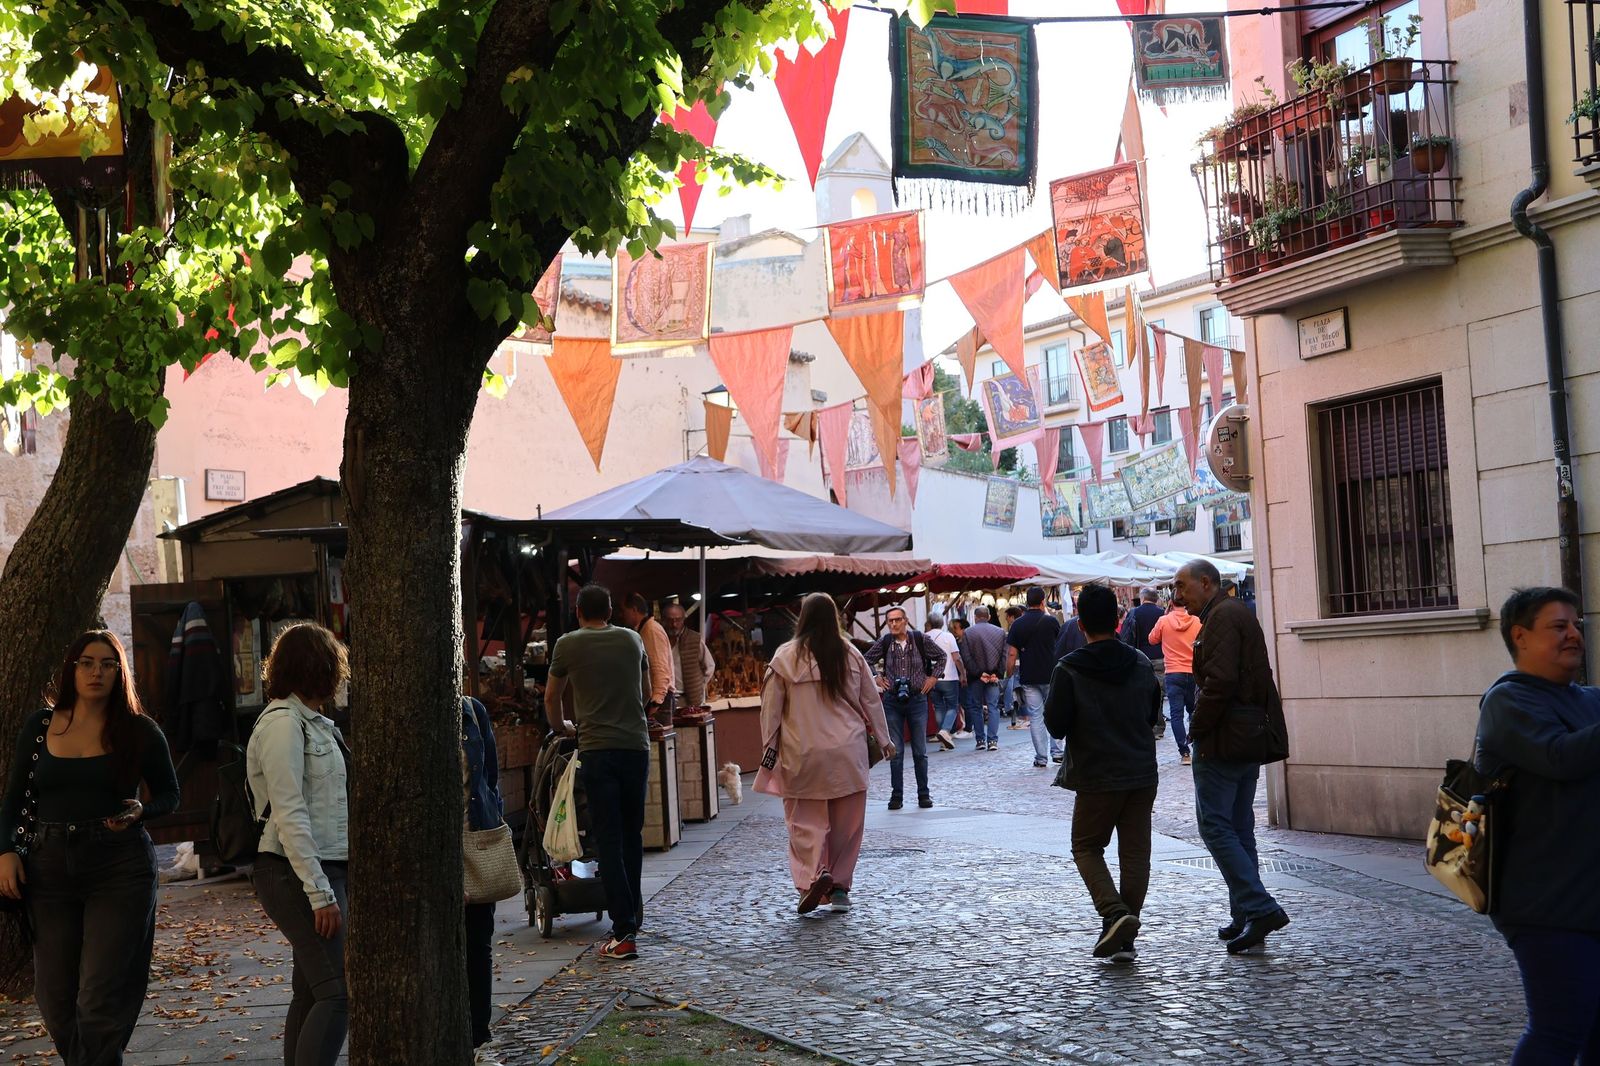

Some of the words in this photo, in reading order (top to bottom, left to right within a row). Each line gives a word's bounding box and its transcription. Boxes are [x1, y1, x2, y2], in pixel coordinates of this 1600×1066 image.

[1313, 318, 1331, 328] PLAZA
[1317, 326, 1326, 334] DE
[1305, 336, 1319, 345] FRAY
[1320, 340, 1335, 350] DEZA
